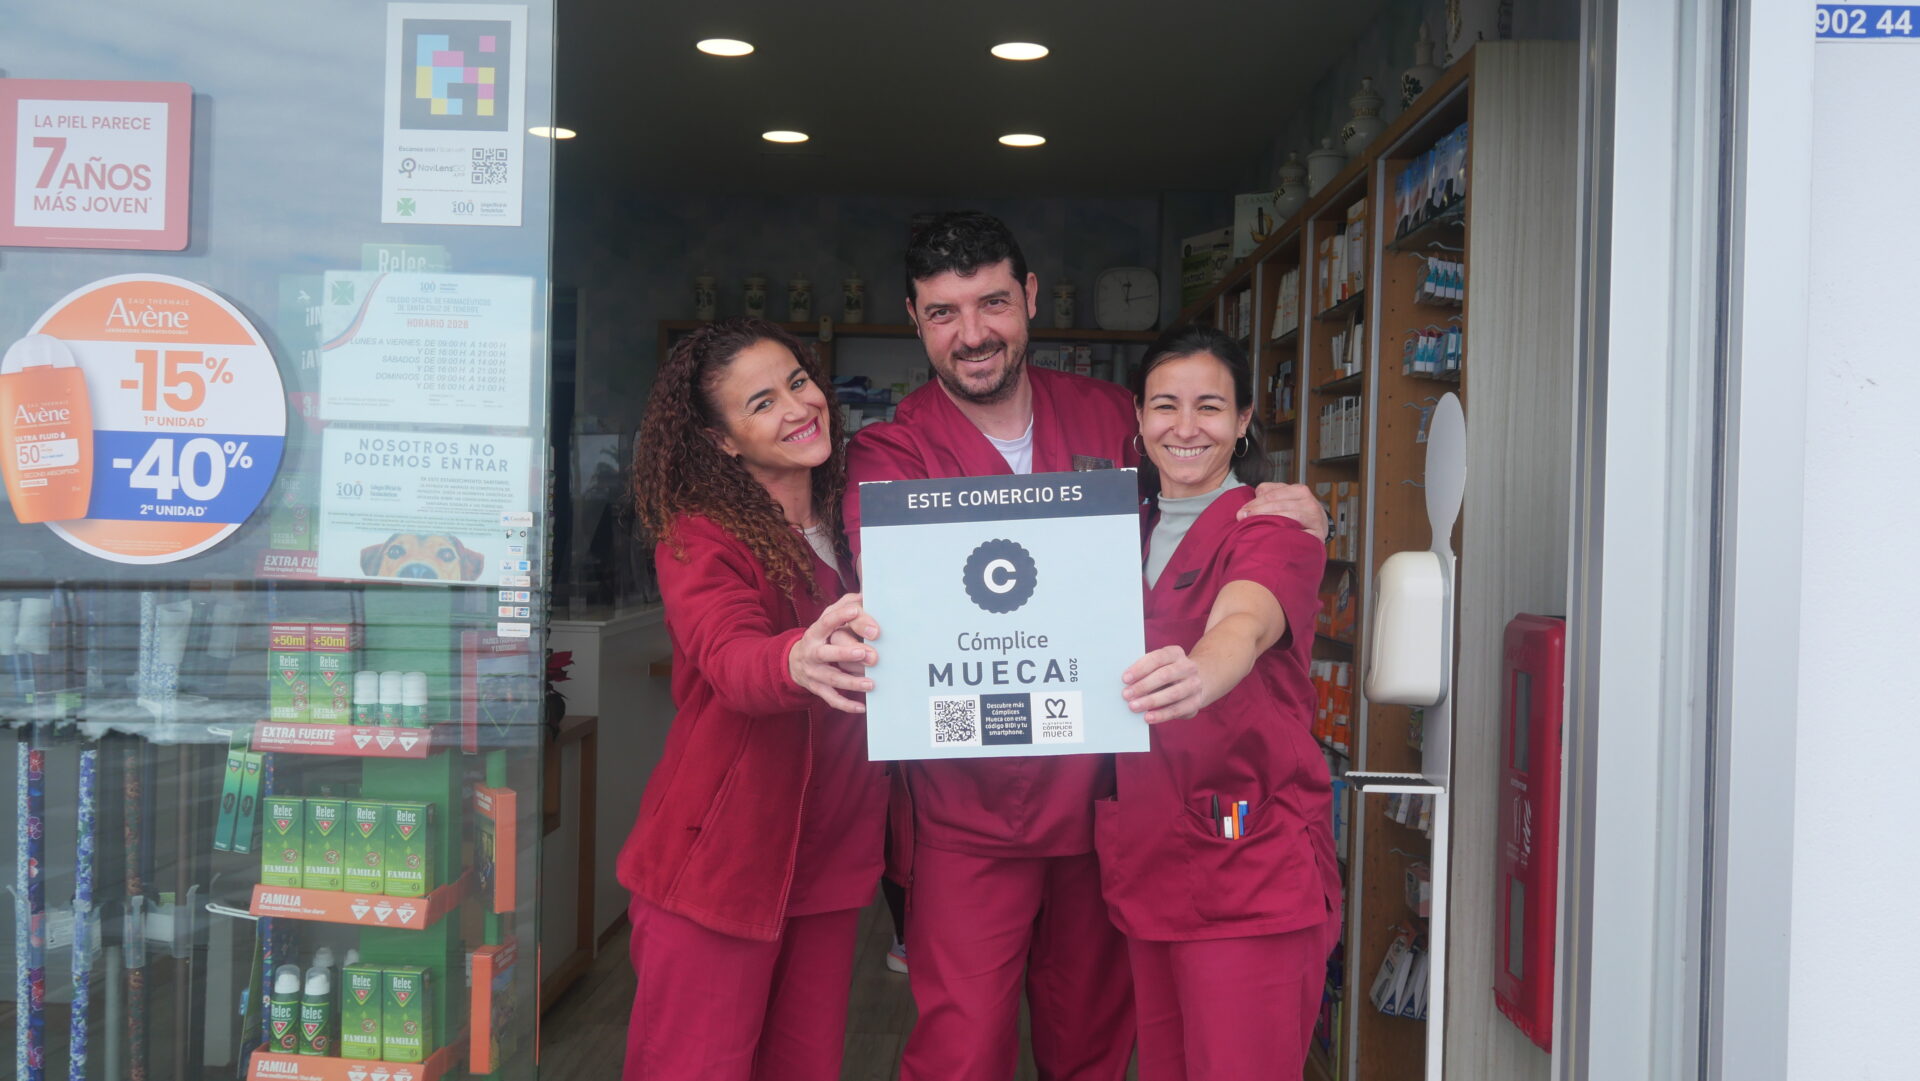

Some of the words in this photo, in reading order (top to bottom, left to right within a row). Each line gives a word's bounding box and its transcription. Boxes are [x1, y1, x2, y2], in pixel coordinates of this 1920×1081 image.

[1816, 8, 1867, 34] 902
[1876, 9, 1913, 35] 44
[34, 115, 53, 128] LA
[57, 115, 88, 129] PIEL
[92, 116, 152, 130] PARECE
[33, 136, 67, 189] 7
[59, 156, 152, 191] AÑOS
[33, 191, 77, 212] MÁS
[106, 297, 190, 328] Avène
[120, 349, 234, 412] -15%
[14, 404, 70, 425] Avène
[359, 438, 459, 455] NOSOTROS
[469, 443, 495, 456] NO
[19, 444, 40, 465] 50
[113, 437, 253, 501] -40%
[344, 452, 431, 469] PODEMOS
[441, 457, 508, 472] ENTRAR
[907, 491, 952, 509] ESTE
[958, 486, 1054, 507] COMERCIO
[1060, 485, 1083, 502] ES
[264, 555, 299, 567] EXTRA
[983, 558, 1017, 594] C
[273, 635, 306, 646] +50ml
[313, 636, 346, 647] +50ml
[957, 630, 1049, 655] Cómplice
[279, 655, 299, 667] Relec
[319, 656, 339, 668] Relec
[928, 658, 1066, 687] MUECA
[1069, 657, 1079, 683] 2026
[985, 722, 1004, 730] código
[989, 729, 1025, 737] smartphone.
[262, 726, 296, 738] EXTRA
[298, 728, 336, 741] FUERTE
[1042, 730, 1073, 738] mueca
[273, 804, 293, 817] Relec
[315, 805, 335, 818] Relec
[356, 807, 376, 820] Relec
[396, 810, 416, 823] Relec
[264, 864, 299, 874] FAMILIA
[305, 866, 341, 876] FAMILIA
[346, 868, 381, 878] FAMILIA
[387, 870, 422, 880] FAMILIA
[260, 892, 301, 906] FAMILIA
[352, 974, 371, 988] Relec
[392, 976, 412, 990] Relec
[271, 1004, 292, 1018] Relec
[301, 1005, 323, 1020] Relec
[343, 1033, 377, 1044] FAMILIA
[385, 1036, 420, 1046] FAMILIA
[257, 1060, 298, 1074] FAMILIA
